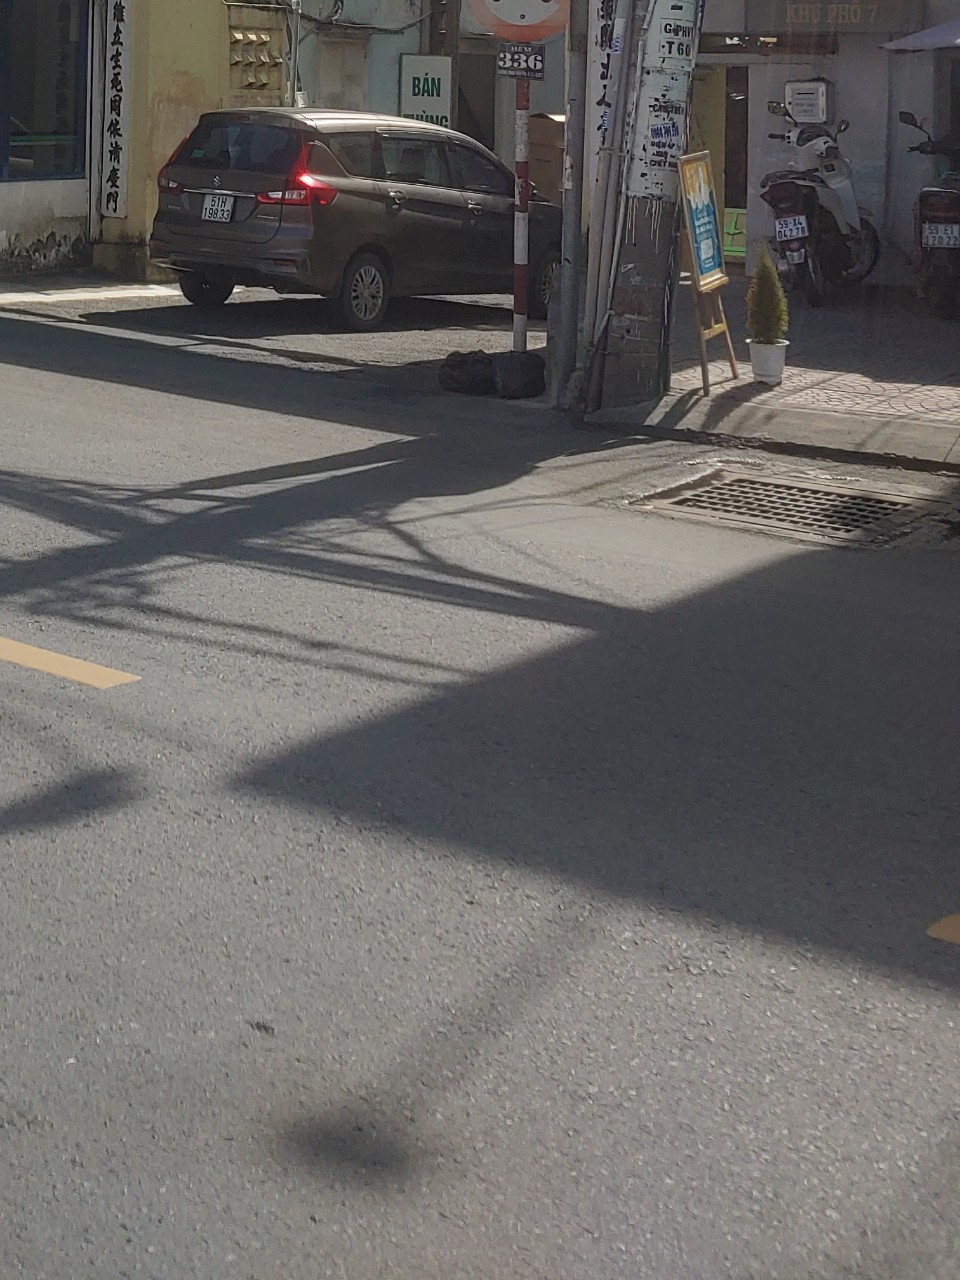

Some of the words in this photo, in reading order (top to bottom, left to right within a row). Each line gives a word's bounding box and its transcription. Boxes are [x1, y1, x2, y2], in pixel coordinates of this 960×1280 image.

[785, 2, 822, 25] KHU
[867, 4, 879, 24] 7
[666, 40, 676, 55] T
[498, 52, 543, 70] 336
[412, 72, 442, 98] BÁN
[211, 196, 227, 208] 51H
[778, 217, 803, 229] 59-X4
